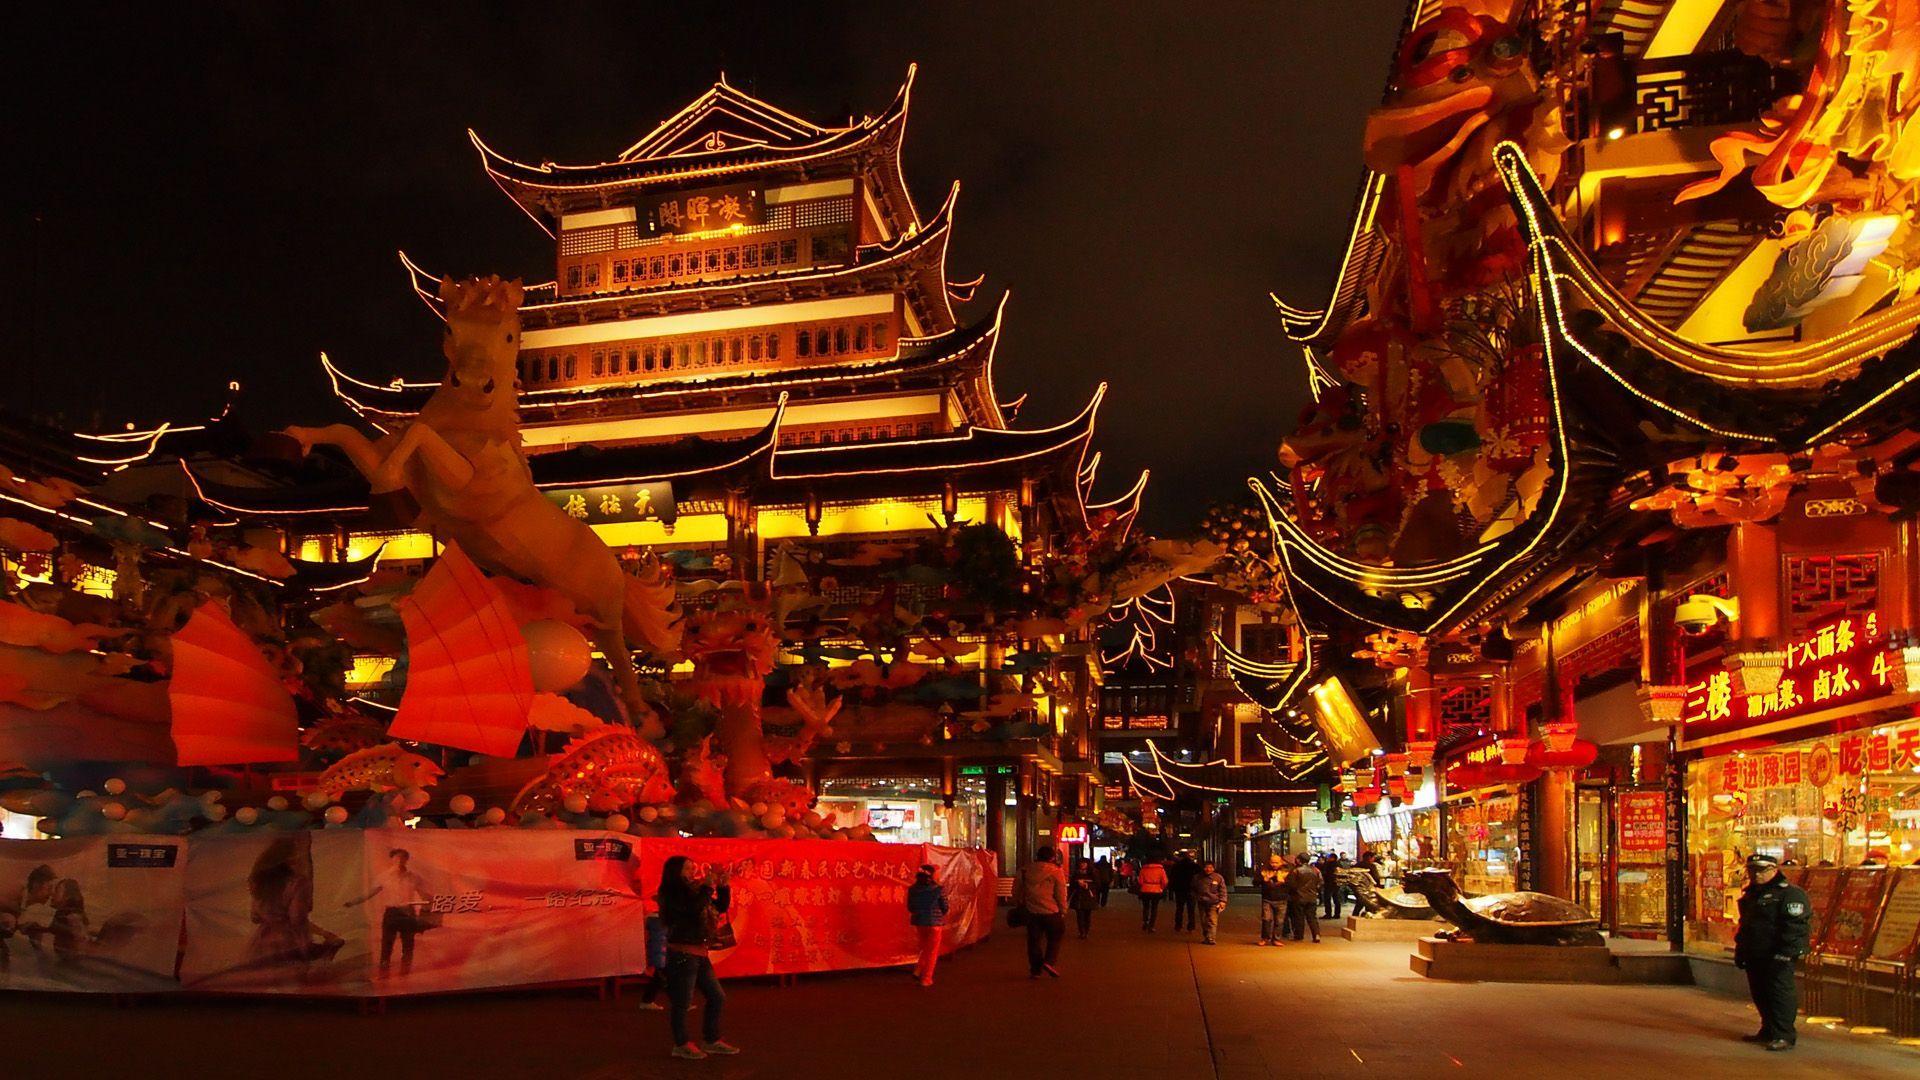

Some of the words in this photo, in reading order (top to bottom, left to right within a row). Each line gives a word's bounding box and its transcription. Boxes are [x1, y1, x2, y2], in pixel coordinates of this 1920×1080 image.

[1685, 671, 1731, 722] 三楼
[1723, 750, 1801, 793] 走进豫园
